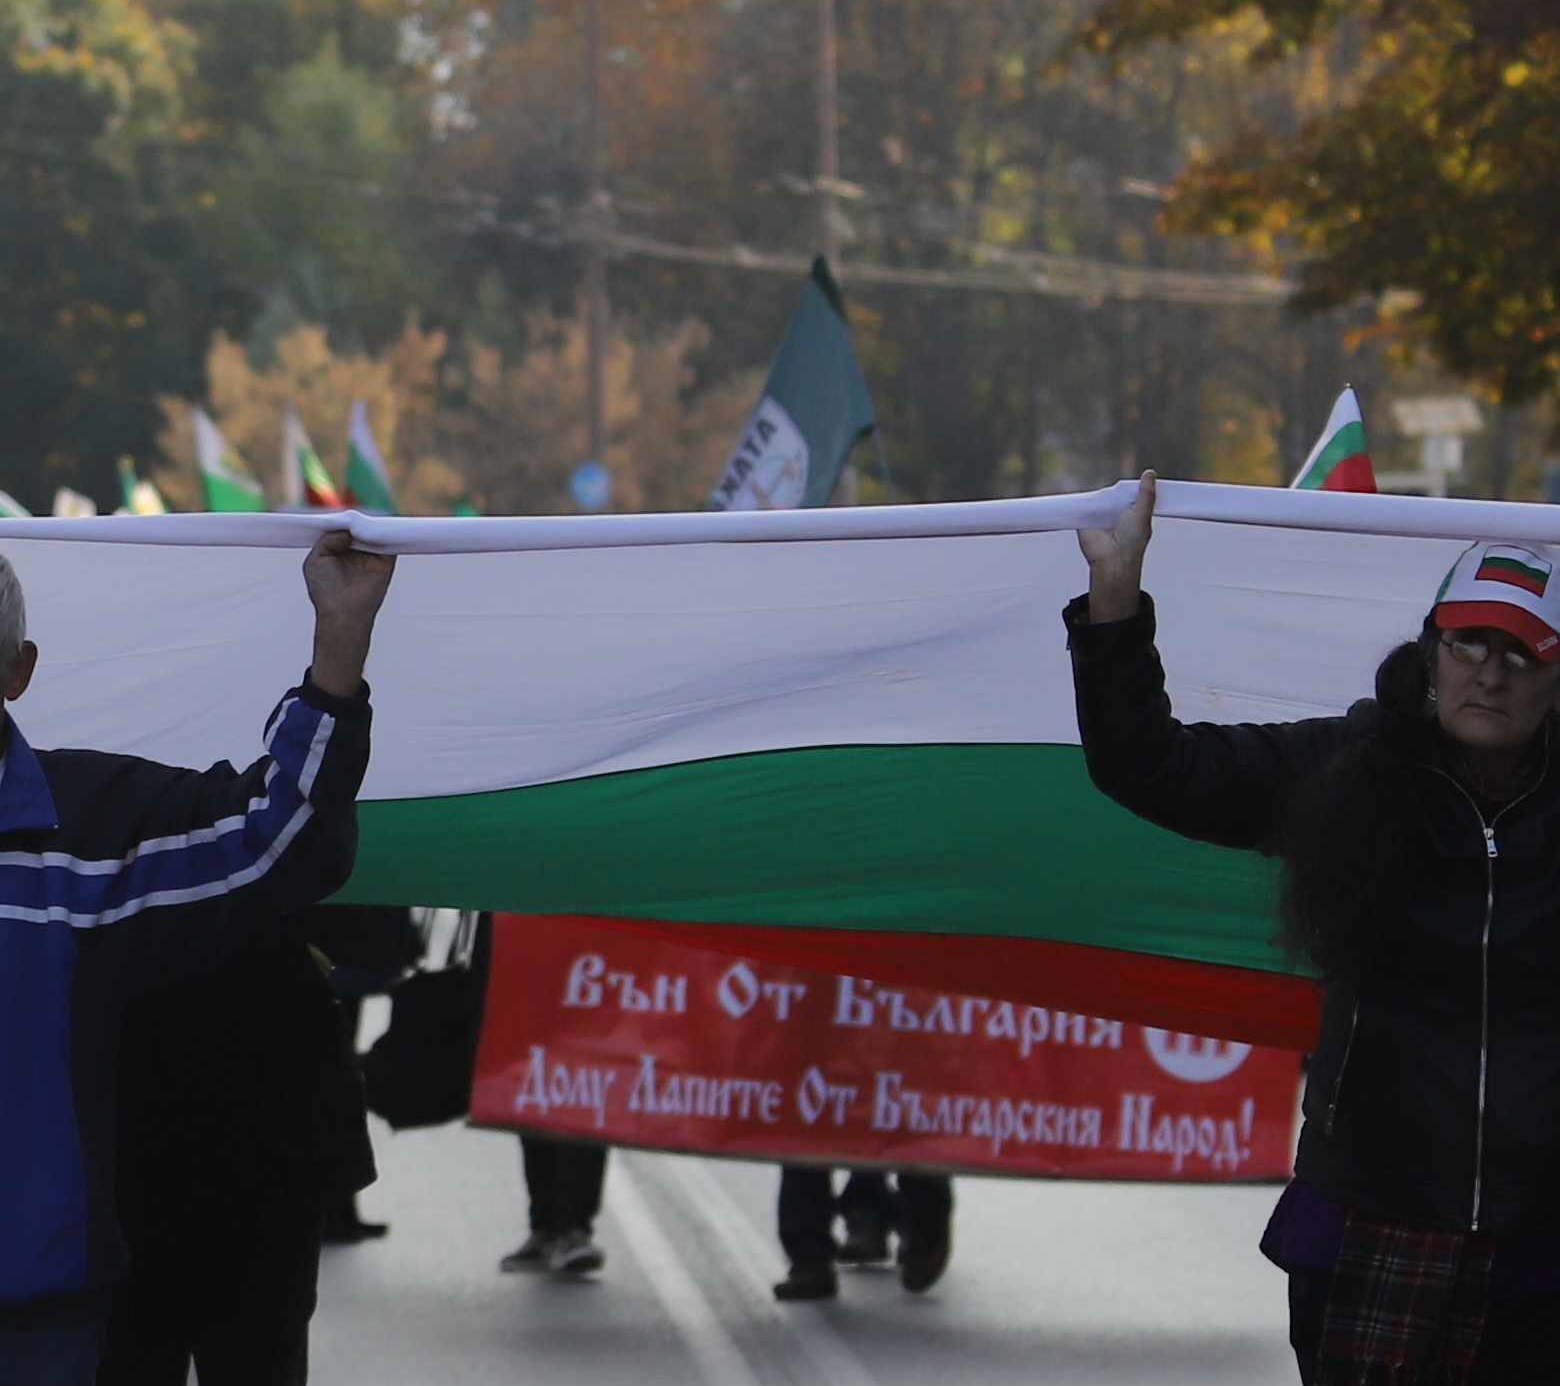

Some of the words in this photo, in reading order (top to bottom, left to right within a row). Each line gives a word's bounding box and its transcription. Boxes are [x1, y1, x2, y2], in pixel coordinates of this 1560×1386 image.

[562, 954, 688, 1014] Вън
[715, 961, 806, 1020] От
[513, 1046, 617, 1128] Долу
[626, 1050, 782, 1122] Лапите
[796, 1066, 858, 1125] От
[872, 1071, 1102, 1158] Българския
[1116, 1092, 1254, 1172] Народ!
